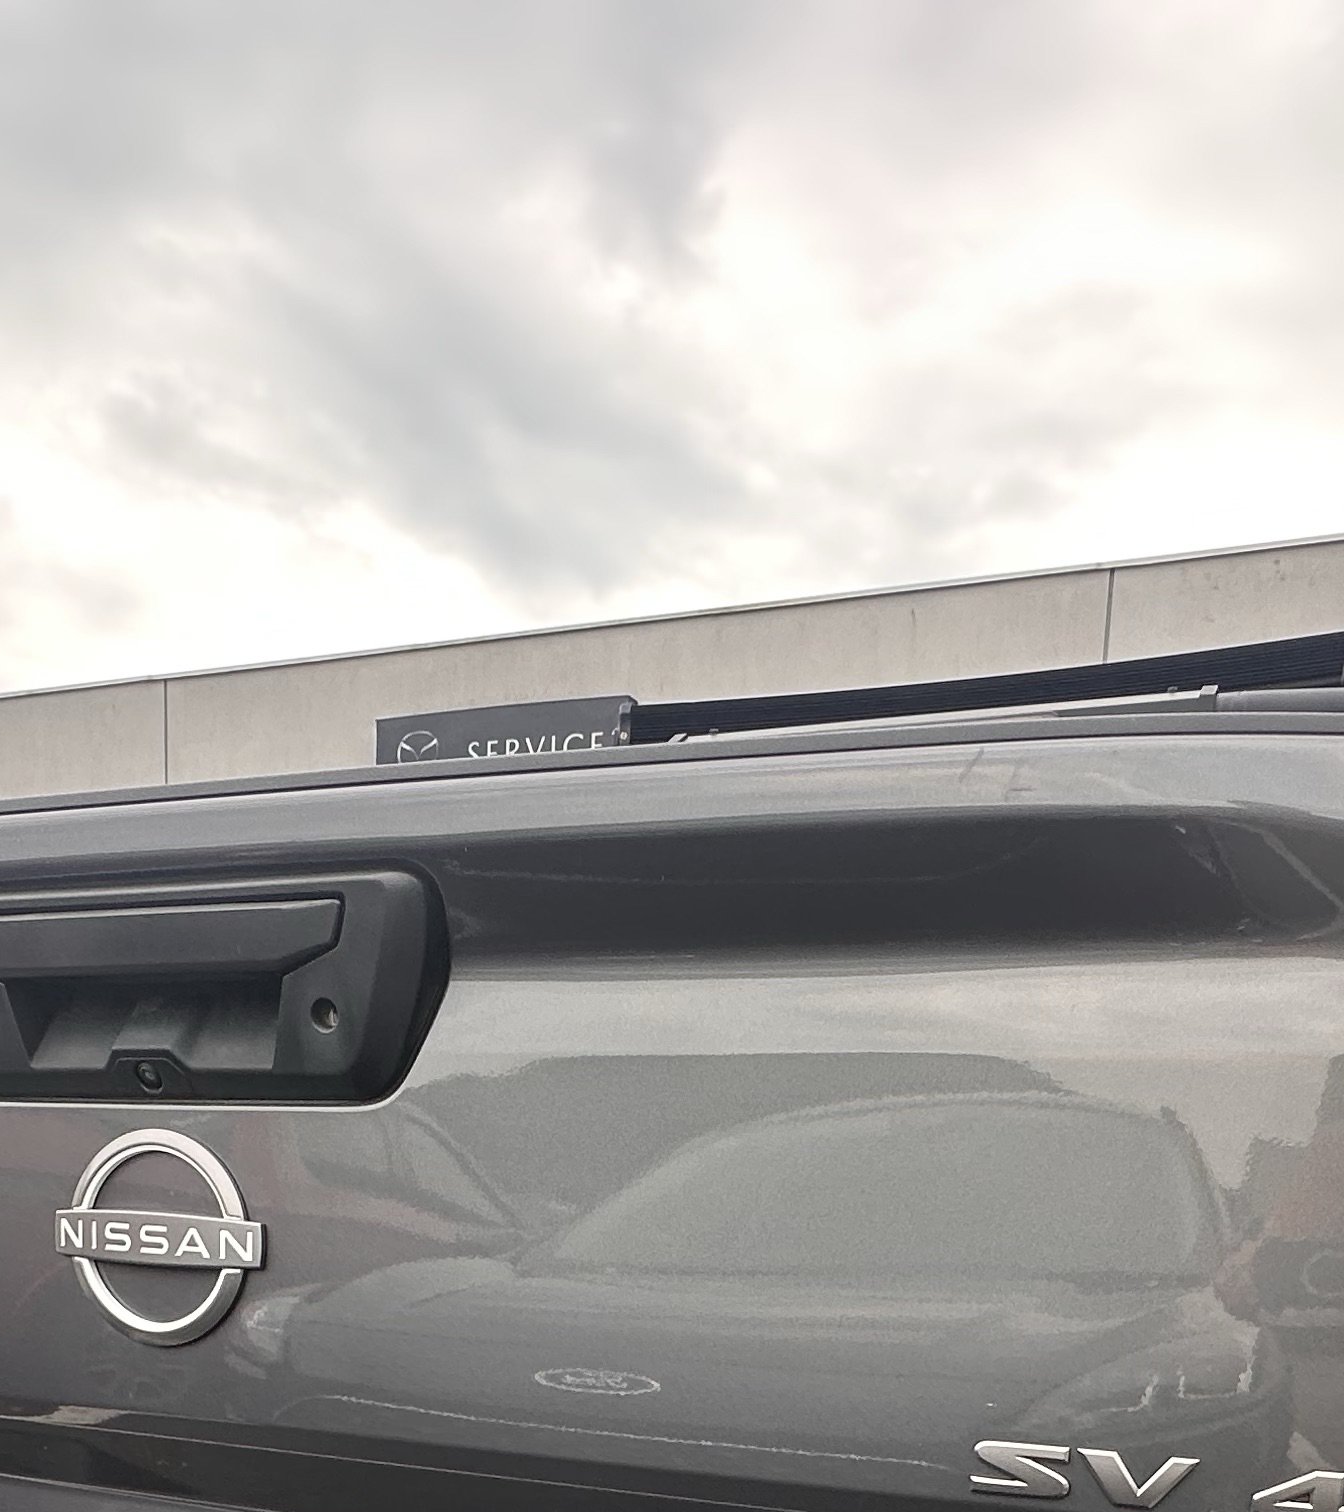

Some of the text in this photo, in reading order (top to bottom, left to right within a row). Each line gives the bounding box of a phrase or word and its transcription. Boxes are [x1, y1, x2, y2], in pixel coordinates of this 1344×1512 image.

[468, 731, 604, 759] SERVICE
[59, 1214, 256, 1263] NISSAN
[969, 1439, 1201, 1510] SV
